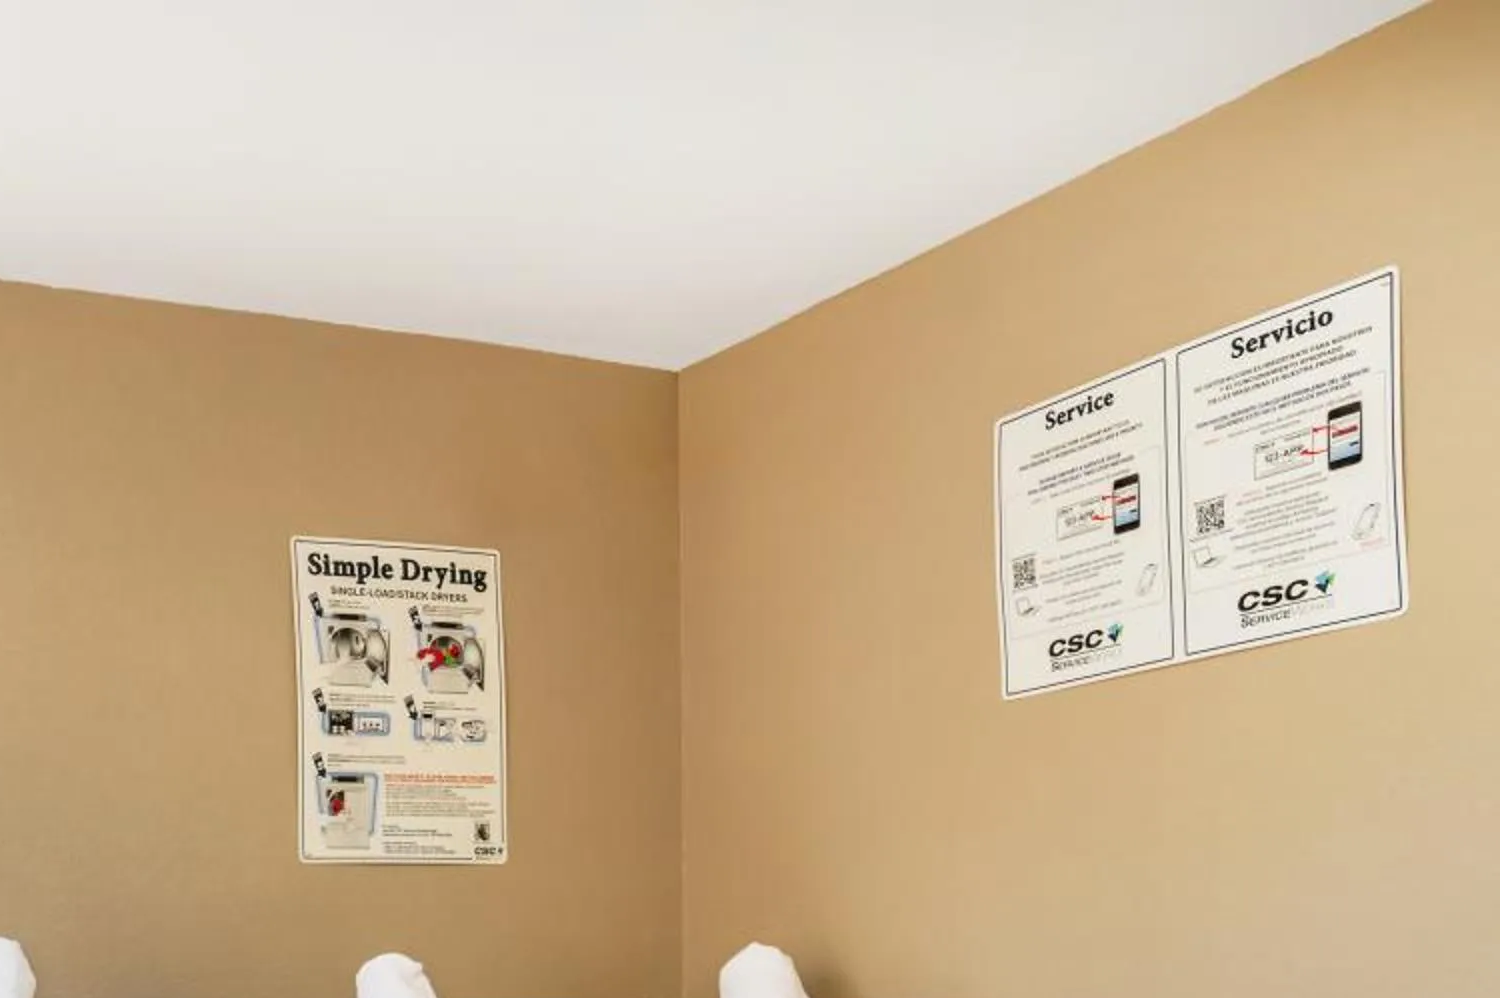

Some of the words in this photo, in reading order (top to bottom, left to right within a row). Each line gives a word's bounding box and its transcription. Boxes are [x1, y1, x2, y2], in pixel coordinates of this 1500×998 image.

[1230, 308, 1333, 359] Servicio
[1044, 390, 1115, 431] Service
[307, 553, 393, 584] Simple
[401, 558, 487, 592] Drying
[430, 591, 469, 602] DRYERS
[1237, 579, 1308, 612] CSC
[1049, 629, 1103, 657] CSC
